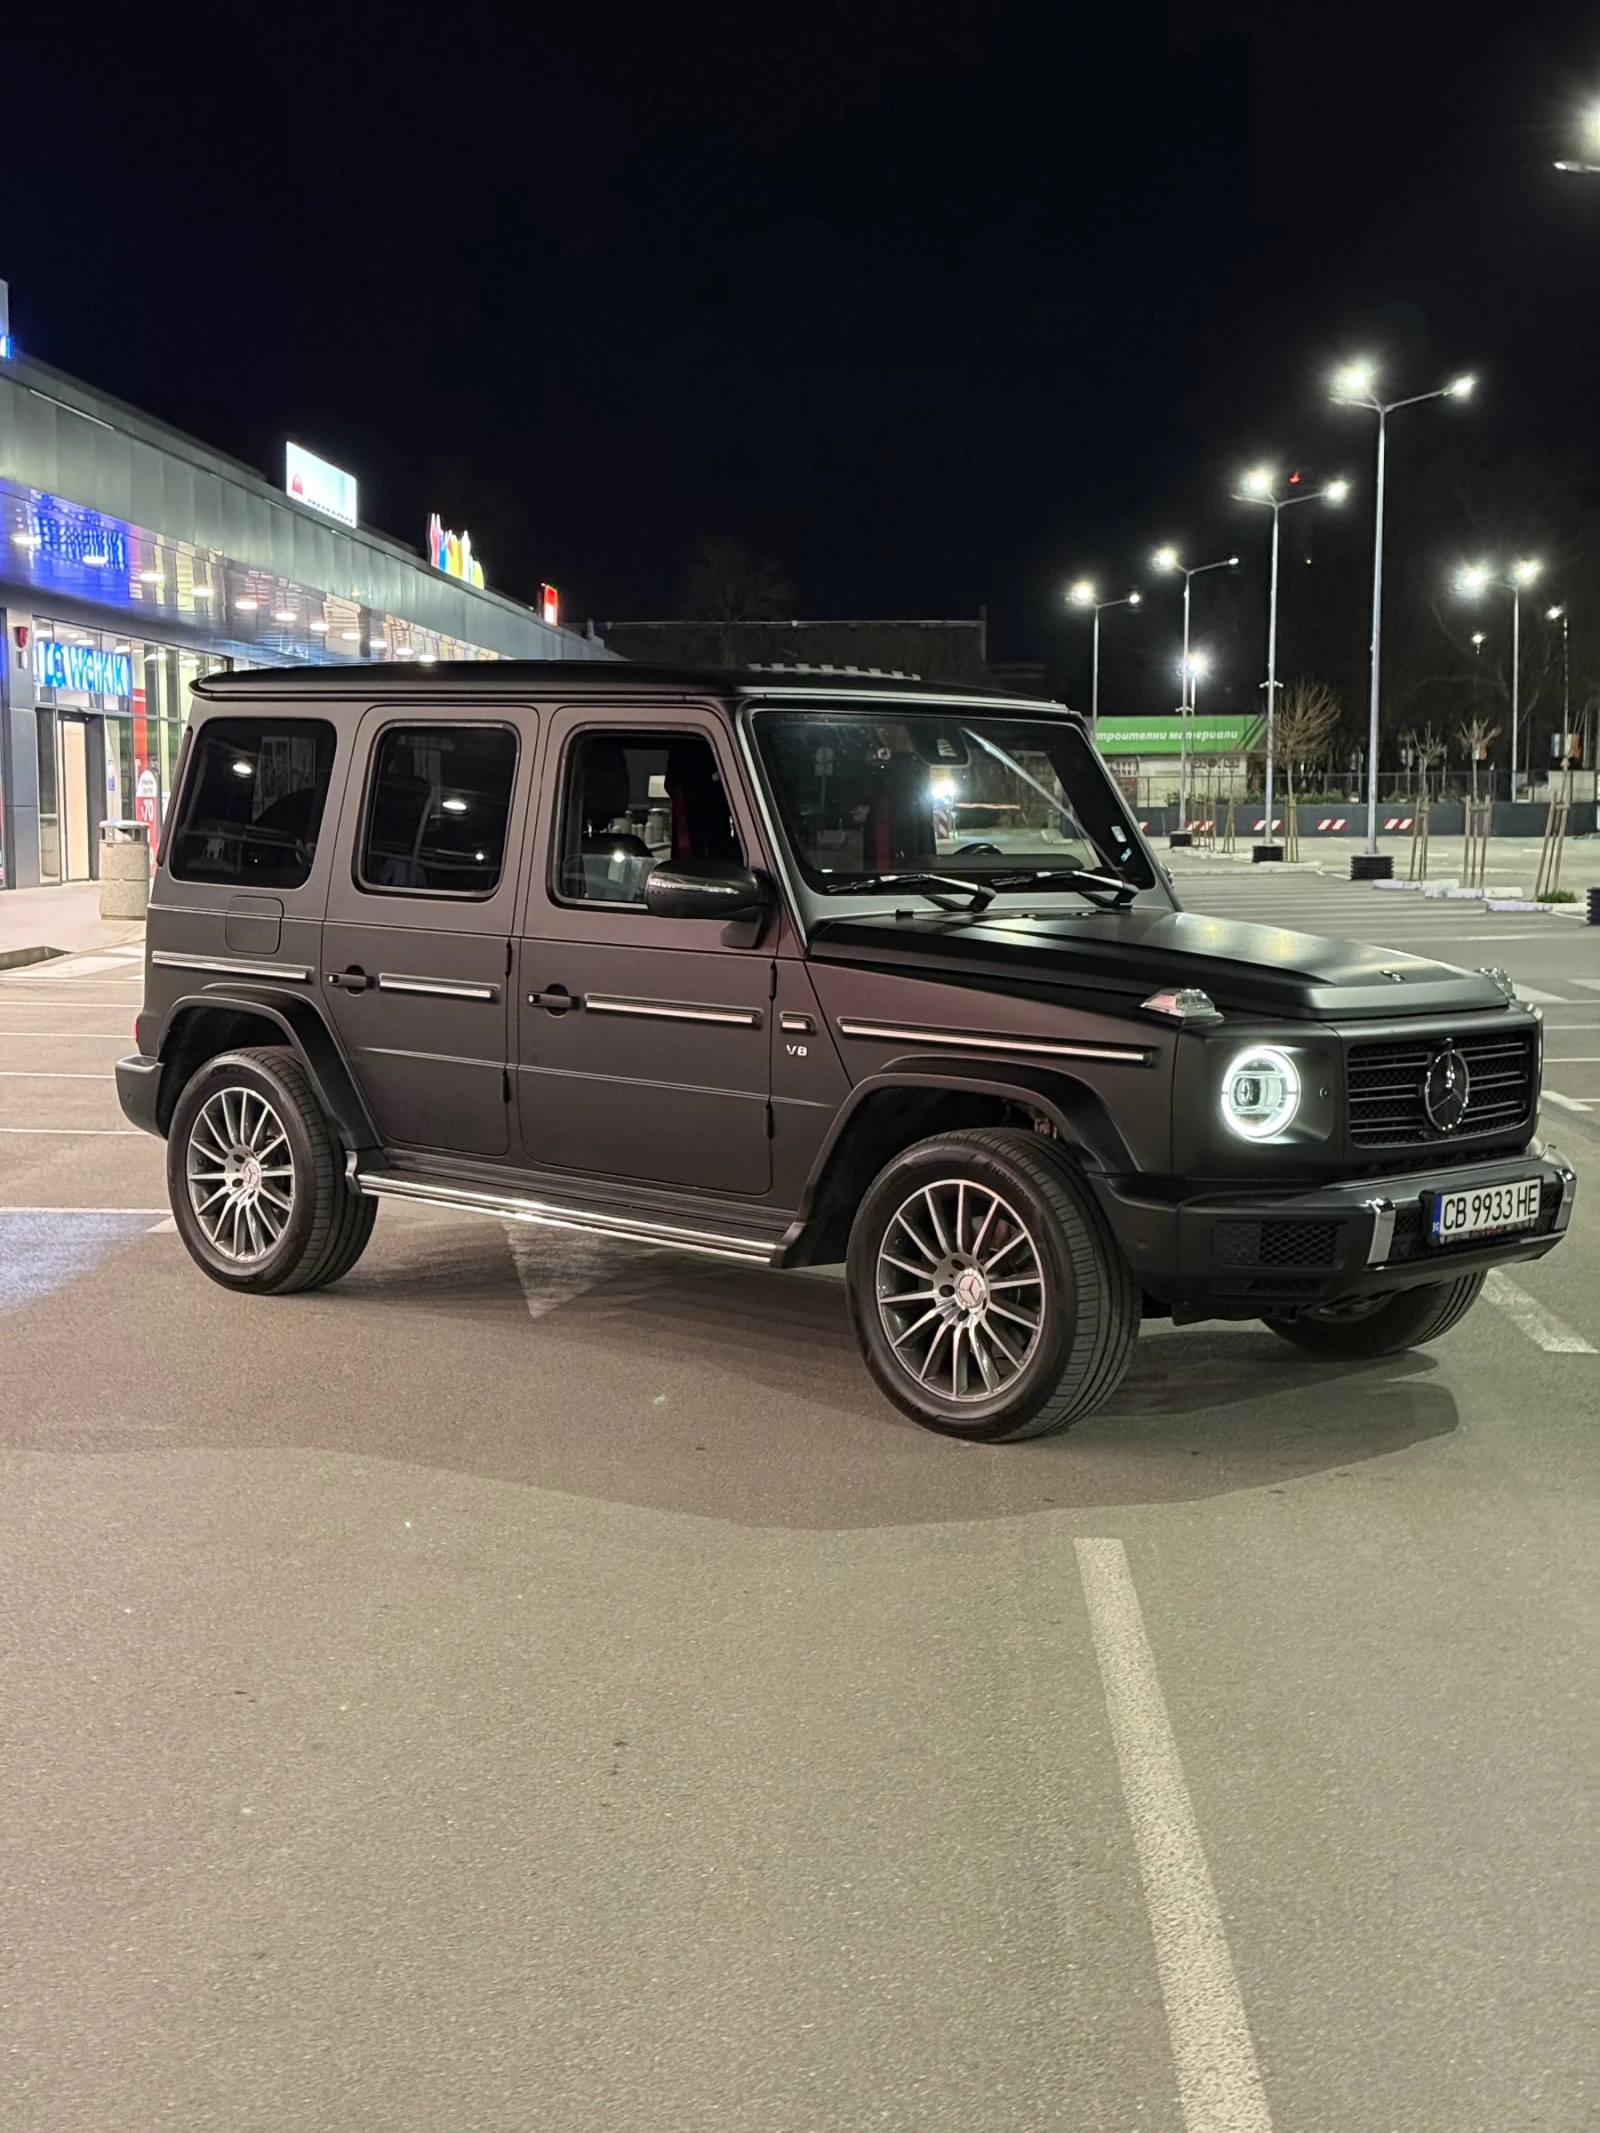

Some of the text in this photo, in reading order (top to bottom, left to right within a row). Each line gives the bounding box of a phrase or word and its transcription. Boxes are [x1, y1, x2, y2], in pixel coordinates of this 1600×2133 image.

[1095, 730, 1167, 742] троителни
[785, 1044, 808, 1057] V8
[1443, 1185, 1538, 1231] CB 9933 HE
